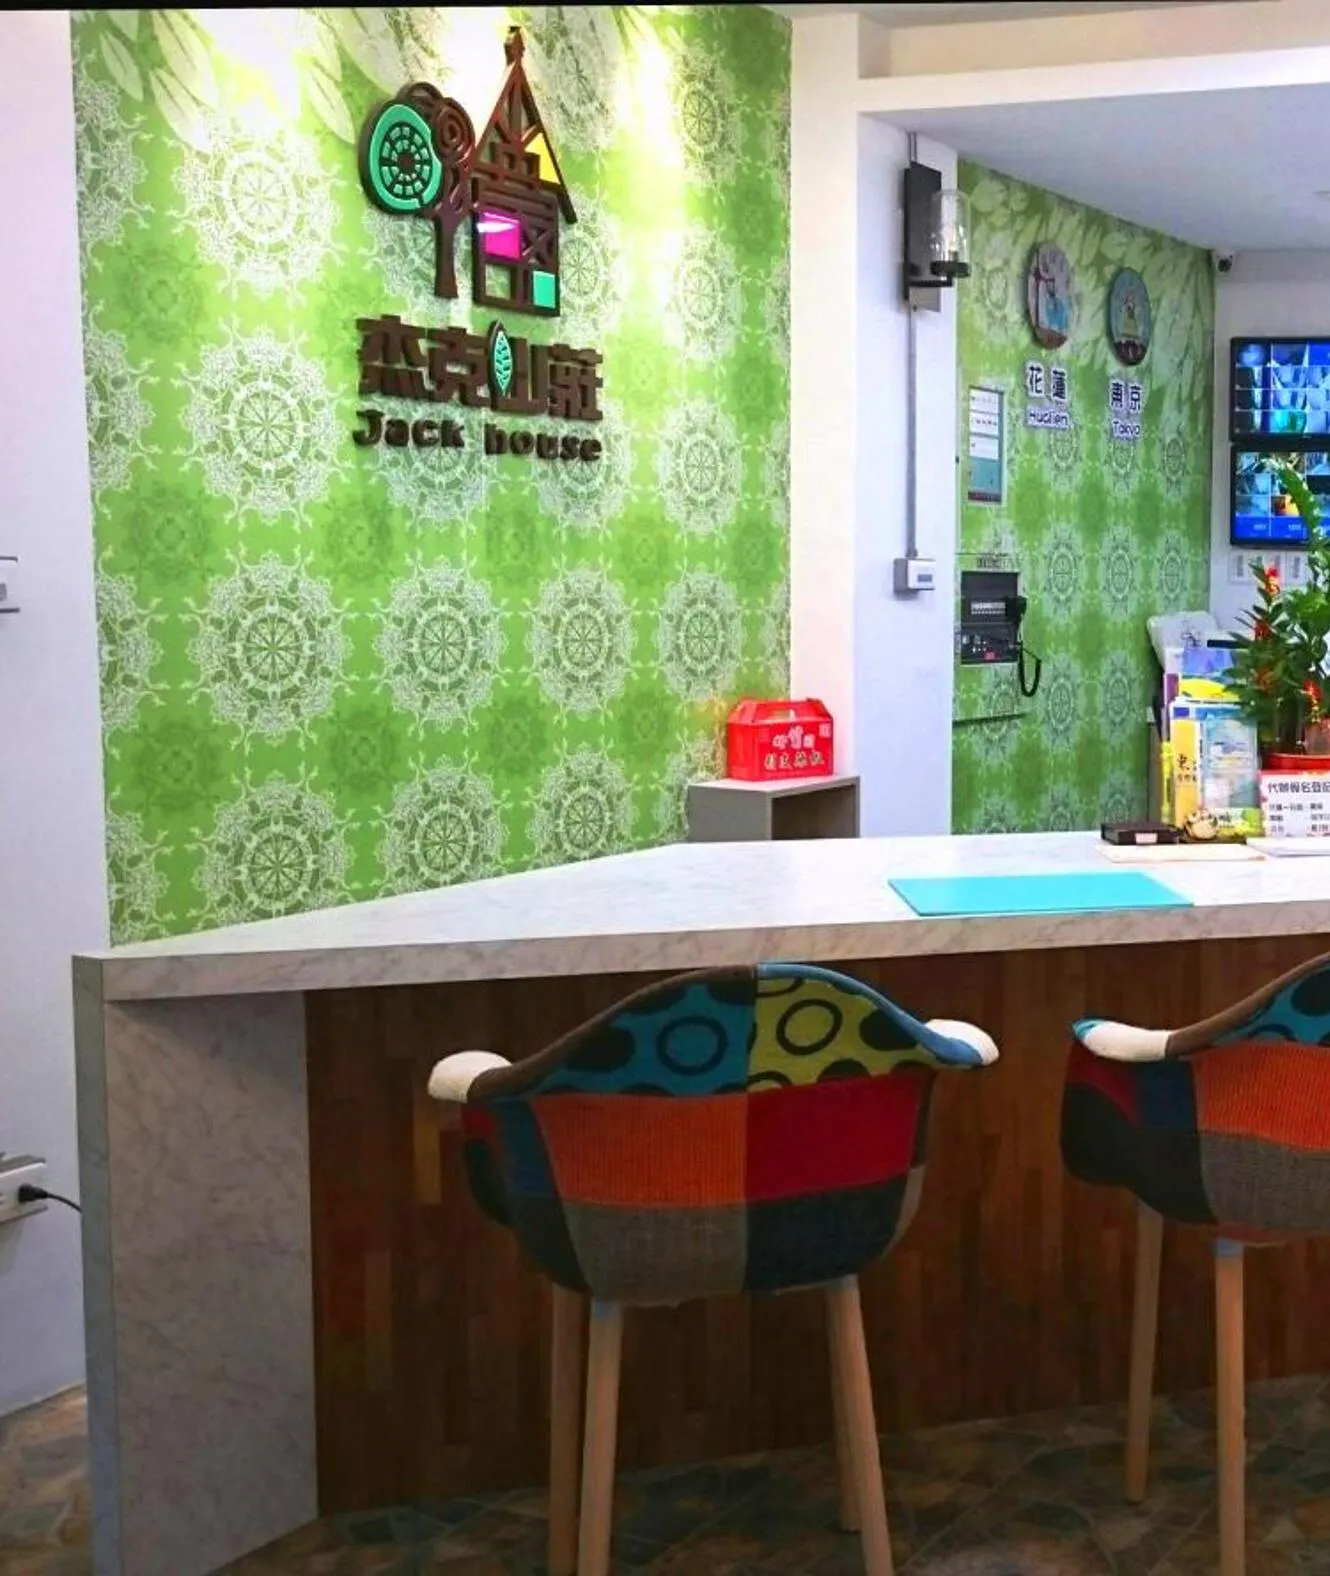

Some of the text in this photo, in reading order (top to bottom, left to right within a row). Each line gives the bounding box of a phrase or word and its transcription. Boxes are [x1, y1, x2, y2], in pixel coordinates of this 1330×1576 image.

[1028, 364, 1067, 400] 花蓮
[353, 408, 603, 462] Jack house
